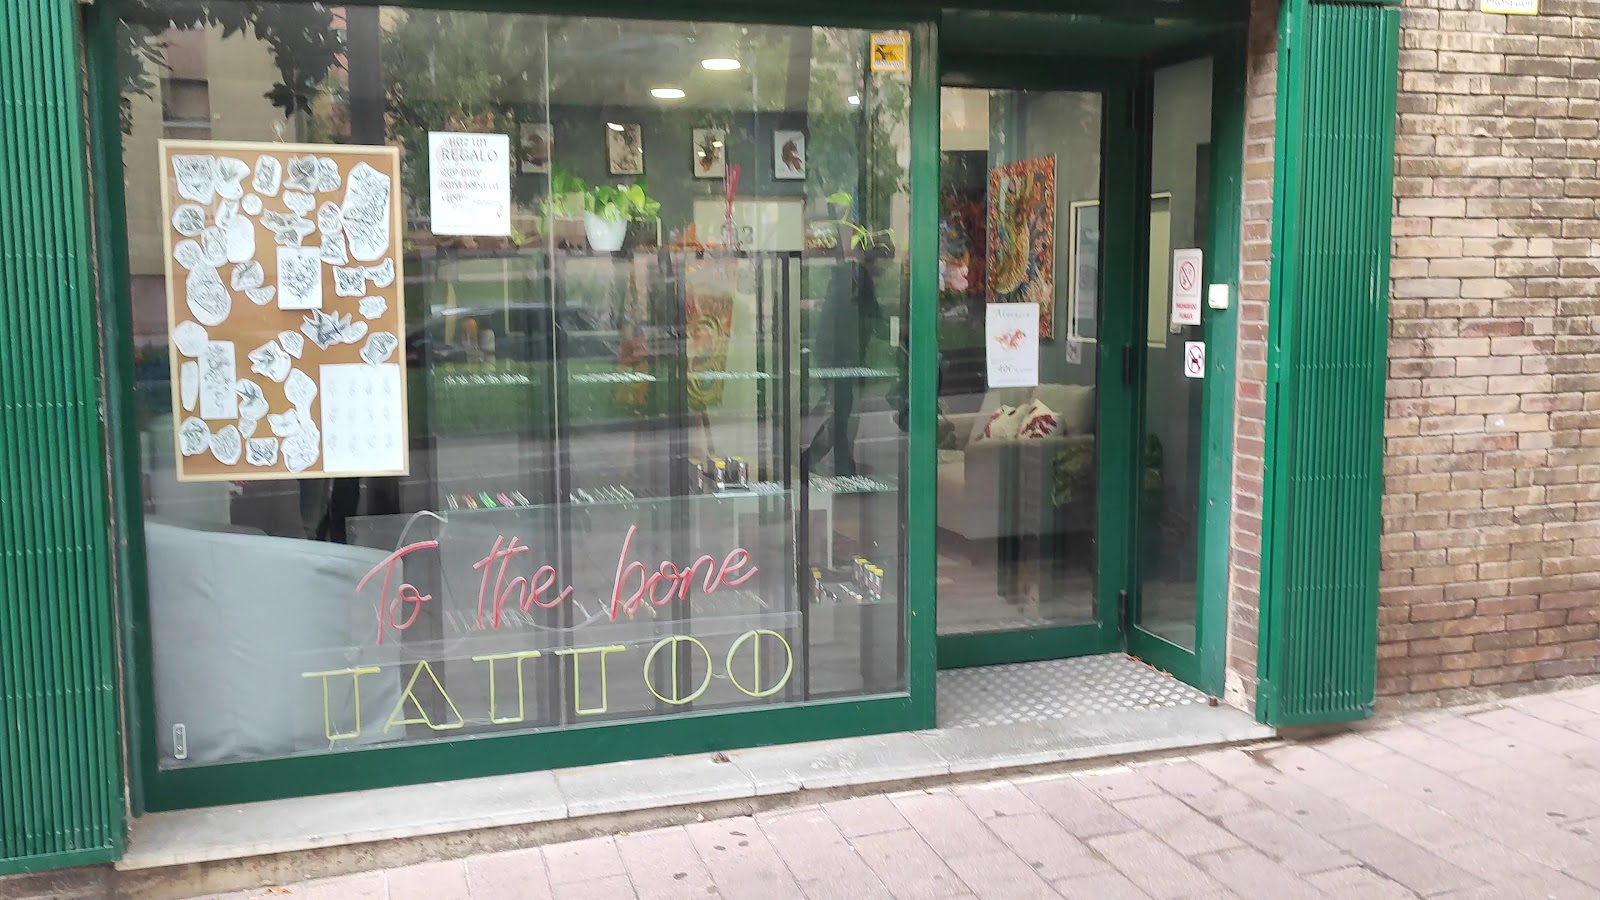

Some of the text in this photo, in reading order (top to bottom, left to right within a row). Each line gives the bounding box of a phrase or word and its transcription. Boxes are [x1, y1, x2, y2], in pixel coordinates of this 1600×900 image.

[441, 148, 498, 162] REGALO
[356, 524, 758, 647] To the bone
[301, 629, 793, 740] TATTOO
